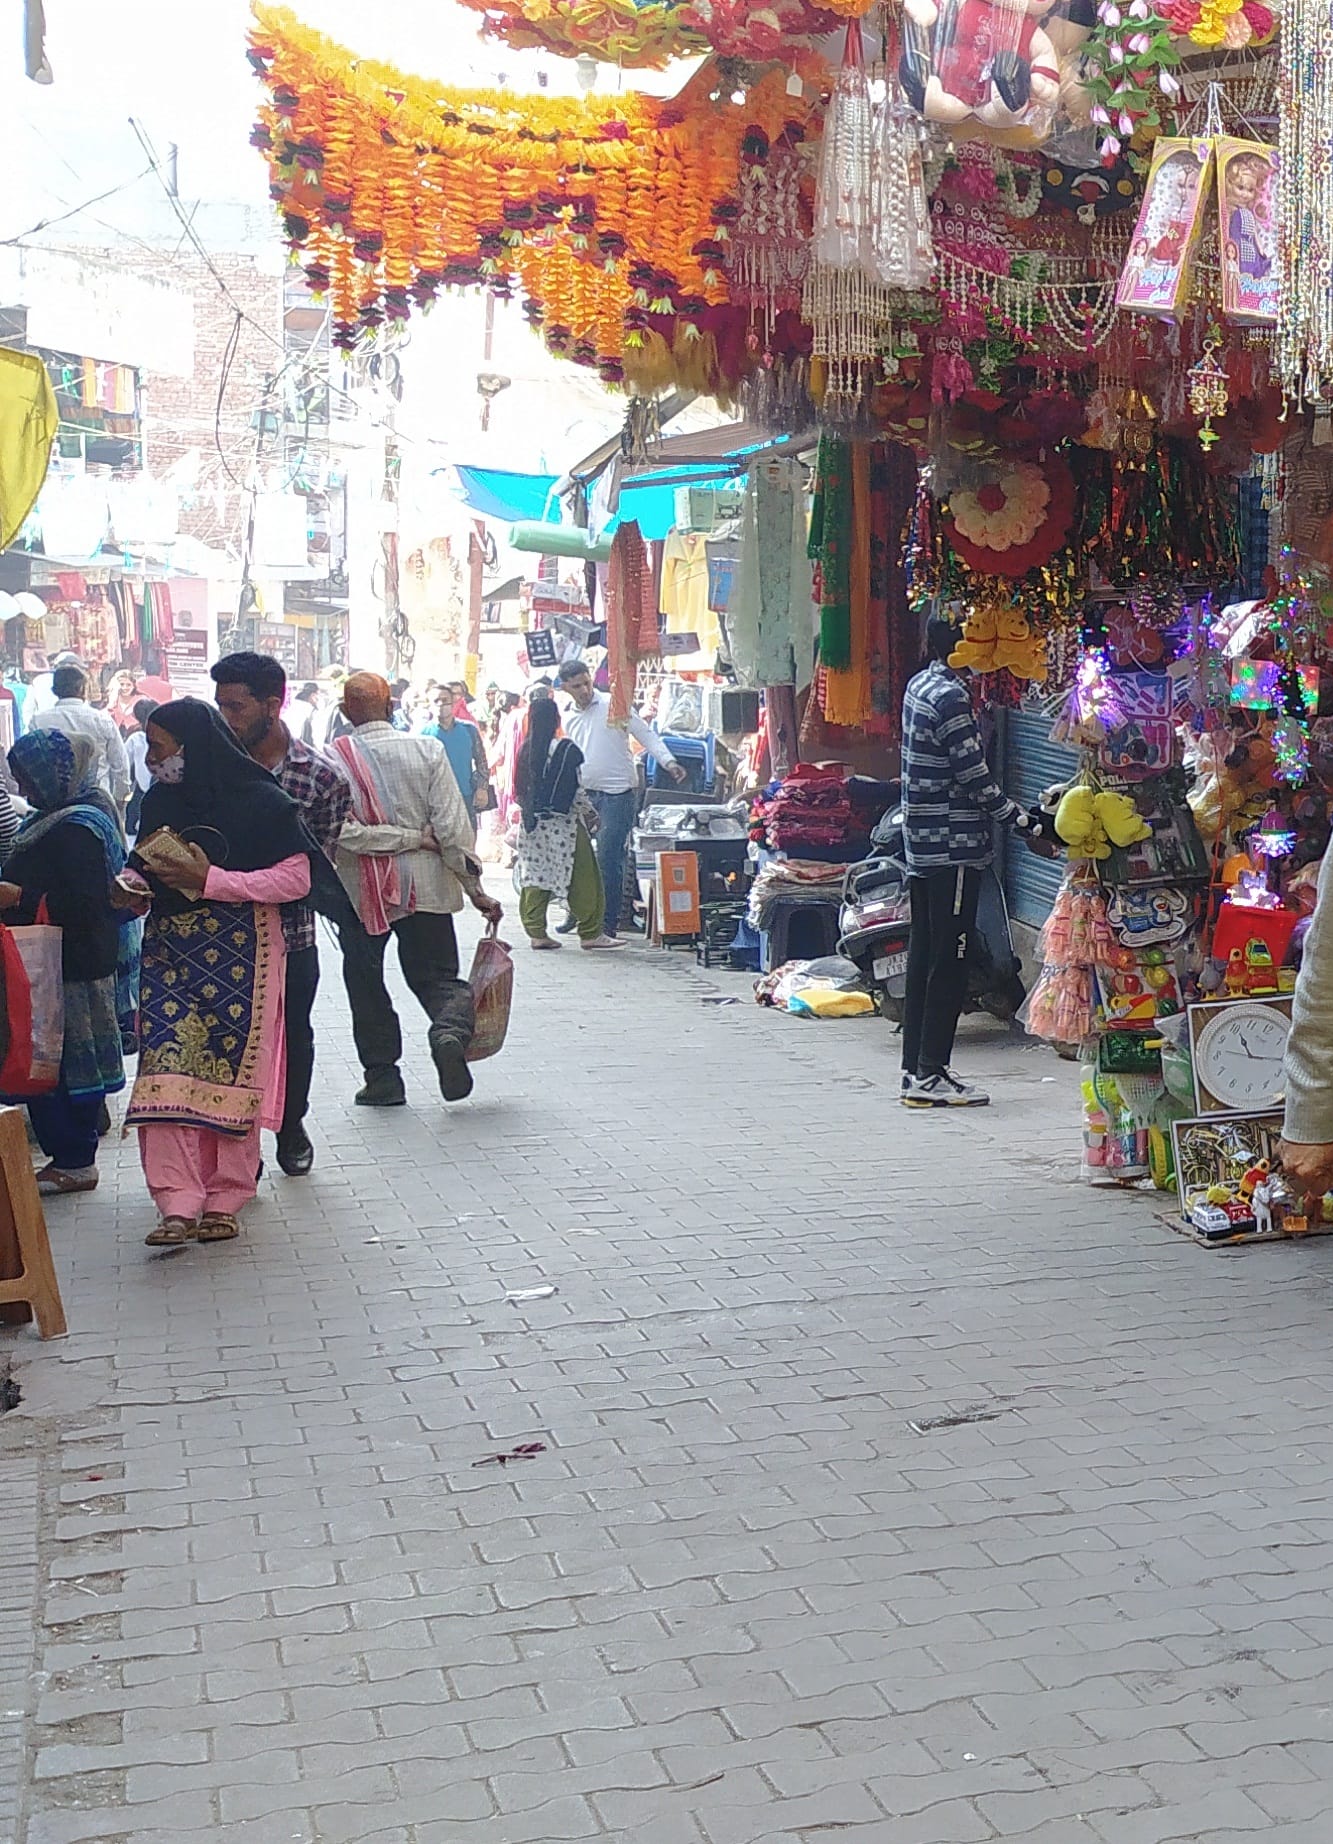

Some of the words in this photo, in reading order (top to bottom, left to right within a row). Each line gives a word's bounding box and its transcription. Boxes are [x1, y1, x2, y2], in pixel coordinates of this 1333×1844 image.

[1229, 1023, 1240, 1034] 10
[1246, 1020, 1257, 1031] 11
[1262, 1023, 1274, 1033] 12
